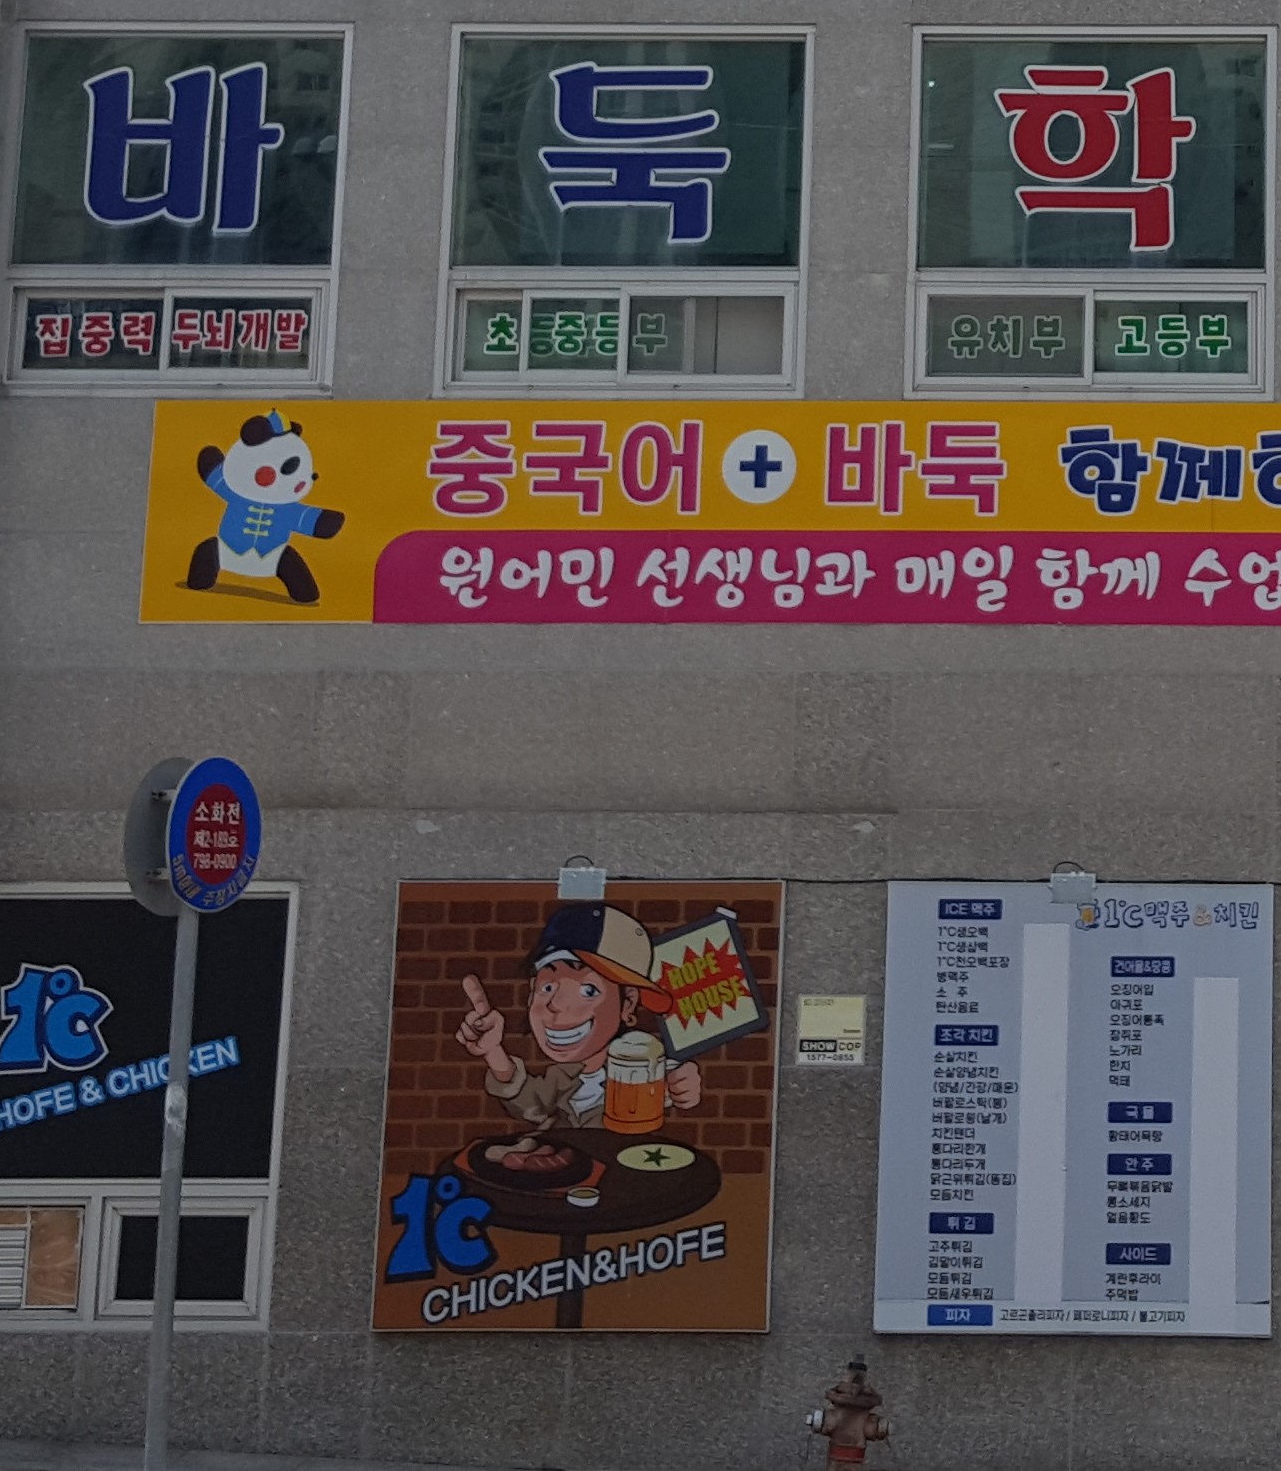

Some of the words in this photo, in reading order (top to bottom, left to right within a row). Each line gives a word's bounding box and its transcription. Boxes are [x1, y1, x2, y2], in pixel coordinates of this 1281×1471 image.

[35, 311, 155, 358] 집중력
[171, 308, 310, 354] 두뇌개발
[947, 315, 1068, 361] 유치부
[1114, 315, 1232, 359] 고등부
[426, 420, 704, 518] 중국어
[824, 420, 1007, 517] 바둑
[440, 546, 616, 609] 원어민
[637, 545, 876, 610] 선생님과
[897, 545, 1015, 612] 매일
[1035, 548, 1162, 610] 함께
[194, 801, 241, 825] 소화전
[945, 902, 968, 915] ICE
[971, 902, 995, 916] 맥주
[667, 951, 721, 990] HOPE
[677, 975, 745, 1019] HOUSE
[968, 1028, 994, 1043] 치킨
[801, 1041, 837, 1052] SHOW
[838, 1041, 861, 1051] COP
[1109, 1044, 1142, 1056] 노가리
[933, 1051, 979, 1063] 순살치킨
[80, 1076, 105, 1105] &
[1119, 1246, 1158, 1262] 사이드
[421, 1223, 726, 1324] CHICKEN&HOFE
[1105, 1272, 1161, 1285] 계란후라이
[1105, 1288, 1139, 1301] 주먹밥
[944, 1308, 971, 1322] 피자
